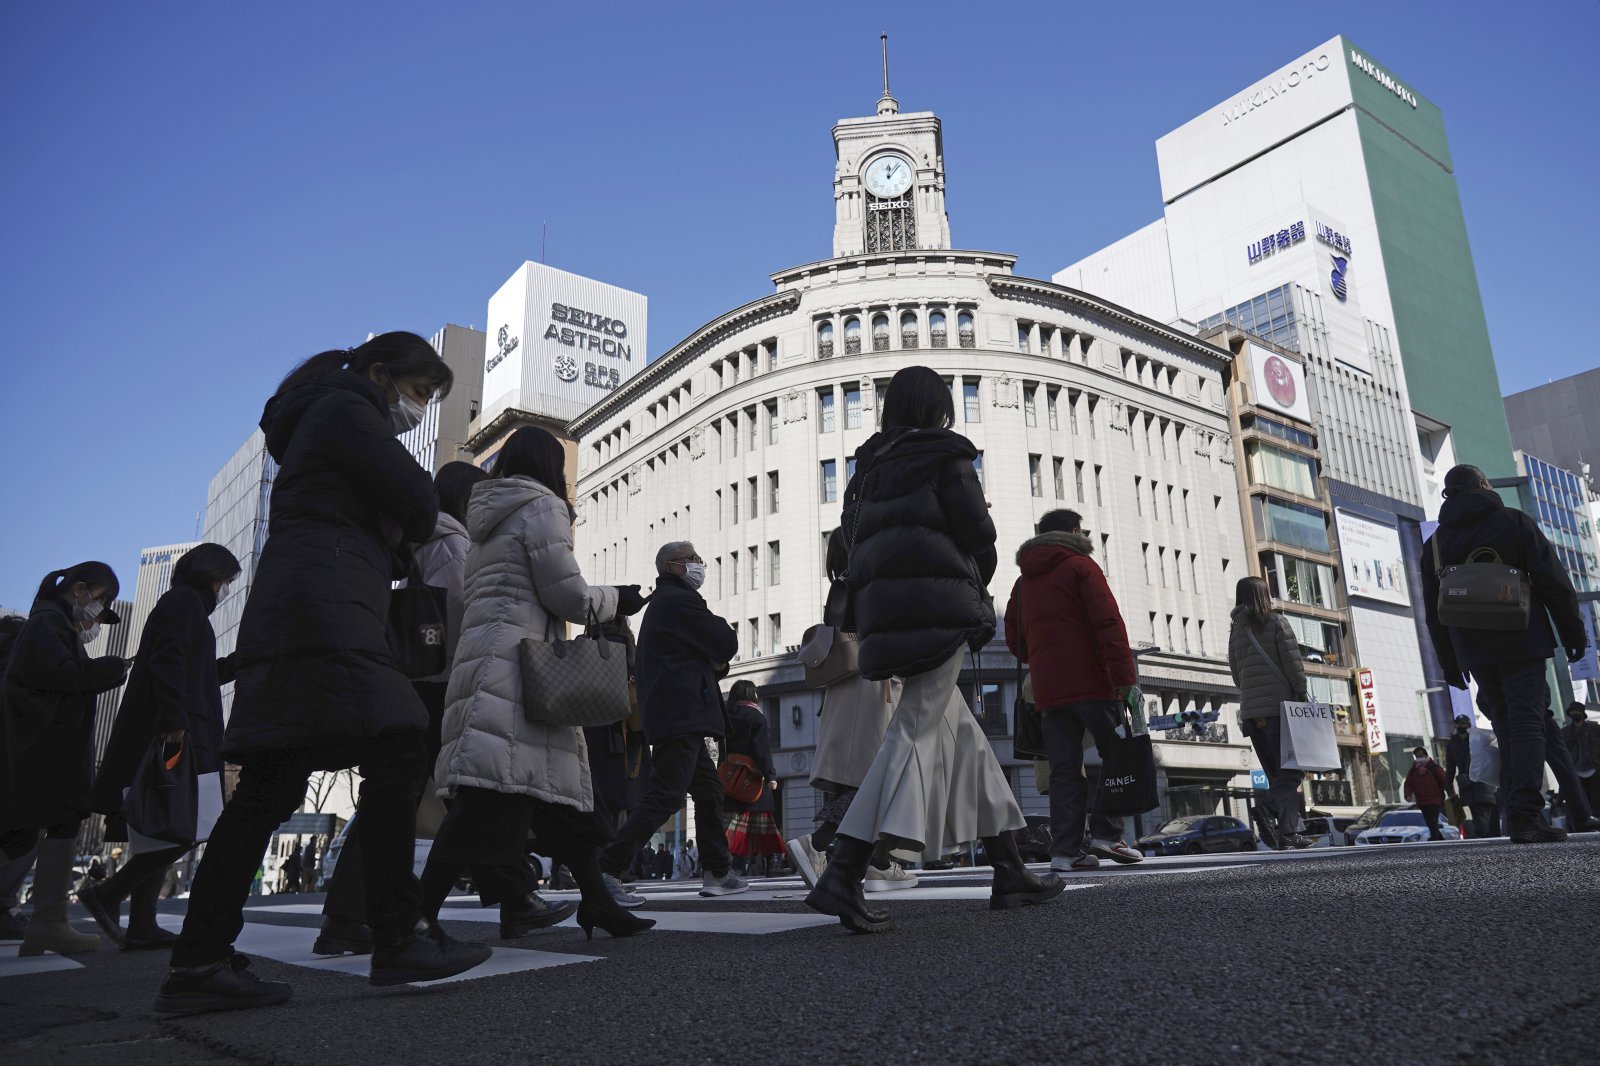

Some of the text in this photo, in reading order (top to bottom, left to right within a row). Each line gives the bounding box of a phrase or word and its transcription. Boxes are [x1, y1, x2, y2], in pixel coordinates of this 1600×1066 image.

[1222, 54, 1331, 127] MIKIMOTO
[1350, 49, 1417, 108] MIKIMOTO
[869, 200, 910, 211] SEIKO
[1247, 220, 1306, 262] 山野楽器
[1315, 220, 1352, 254] 山野楽器
[551, 302, 627, 338] SEIKO
[544, 323, 632, 362] ASTRON
[585, 362, 619, 380] GPS
[1289, 706, 1328, 719] LOEWE
[1364, 692, 1381, 748] キムラヤのパン
